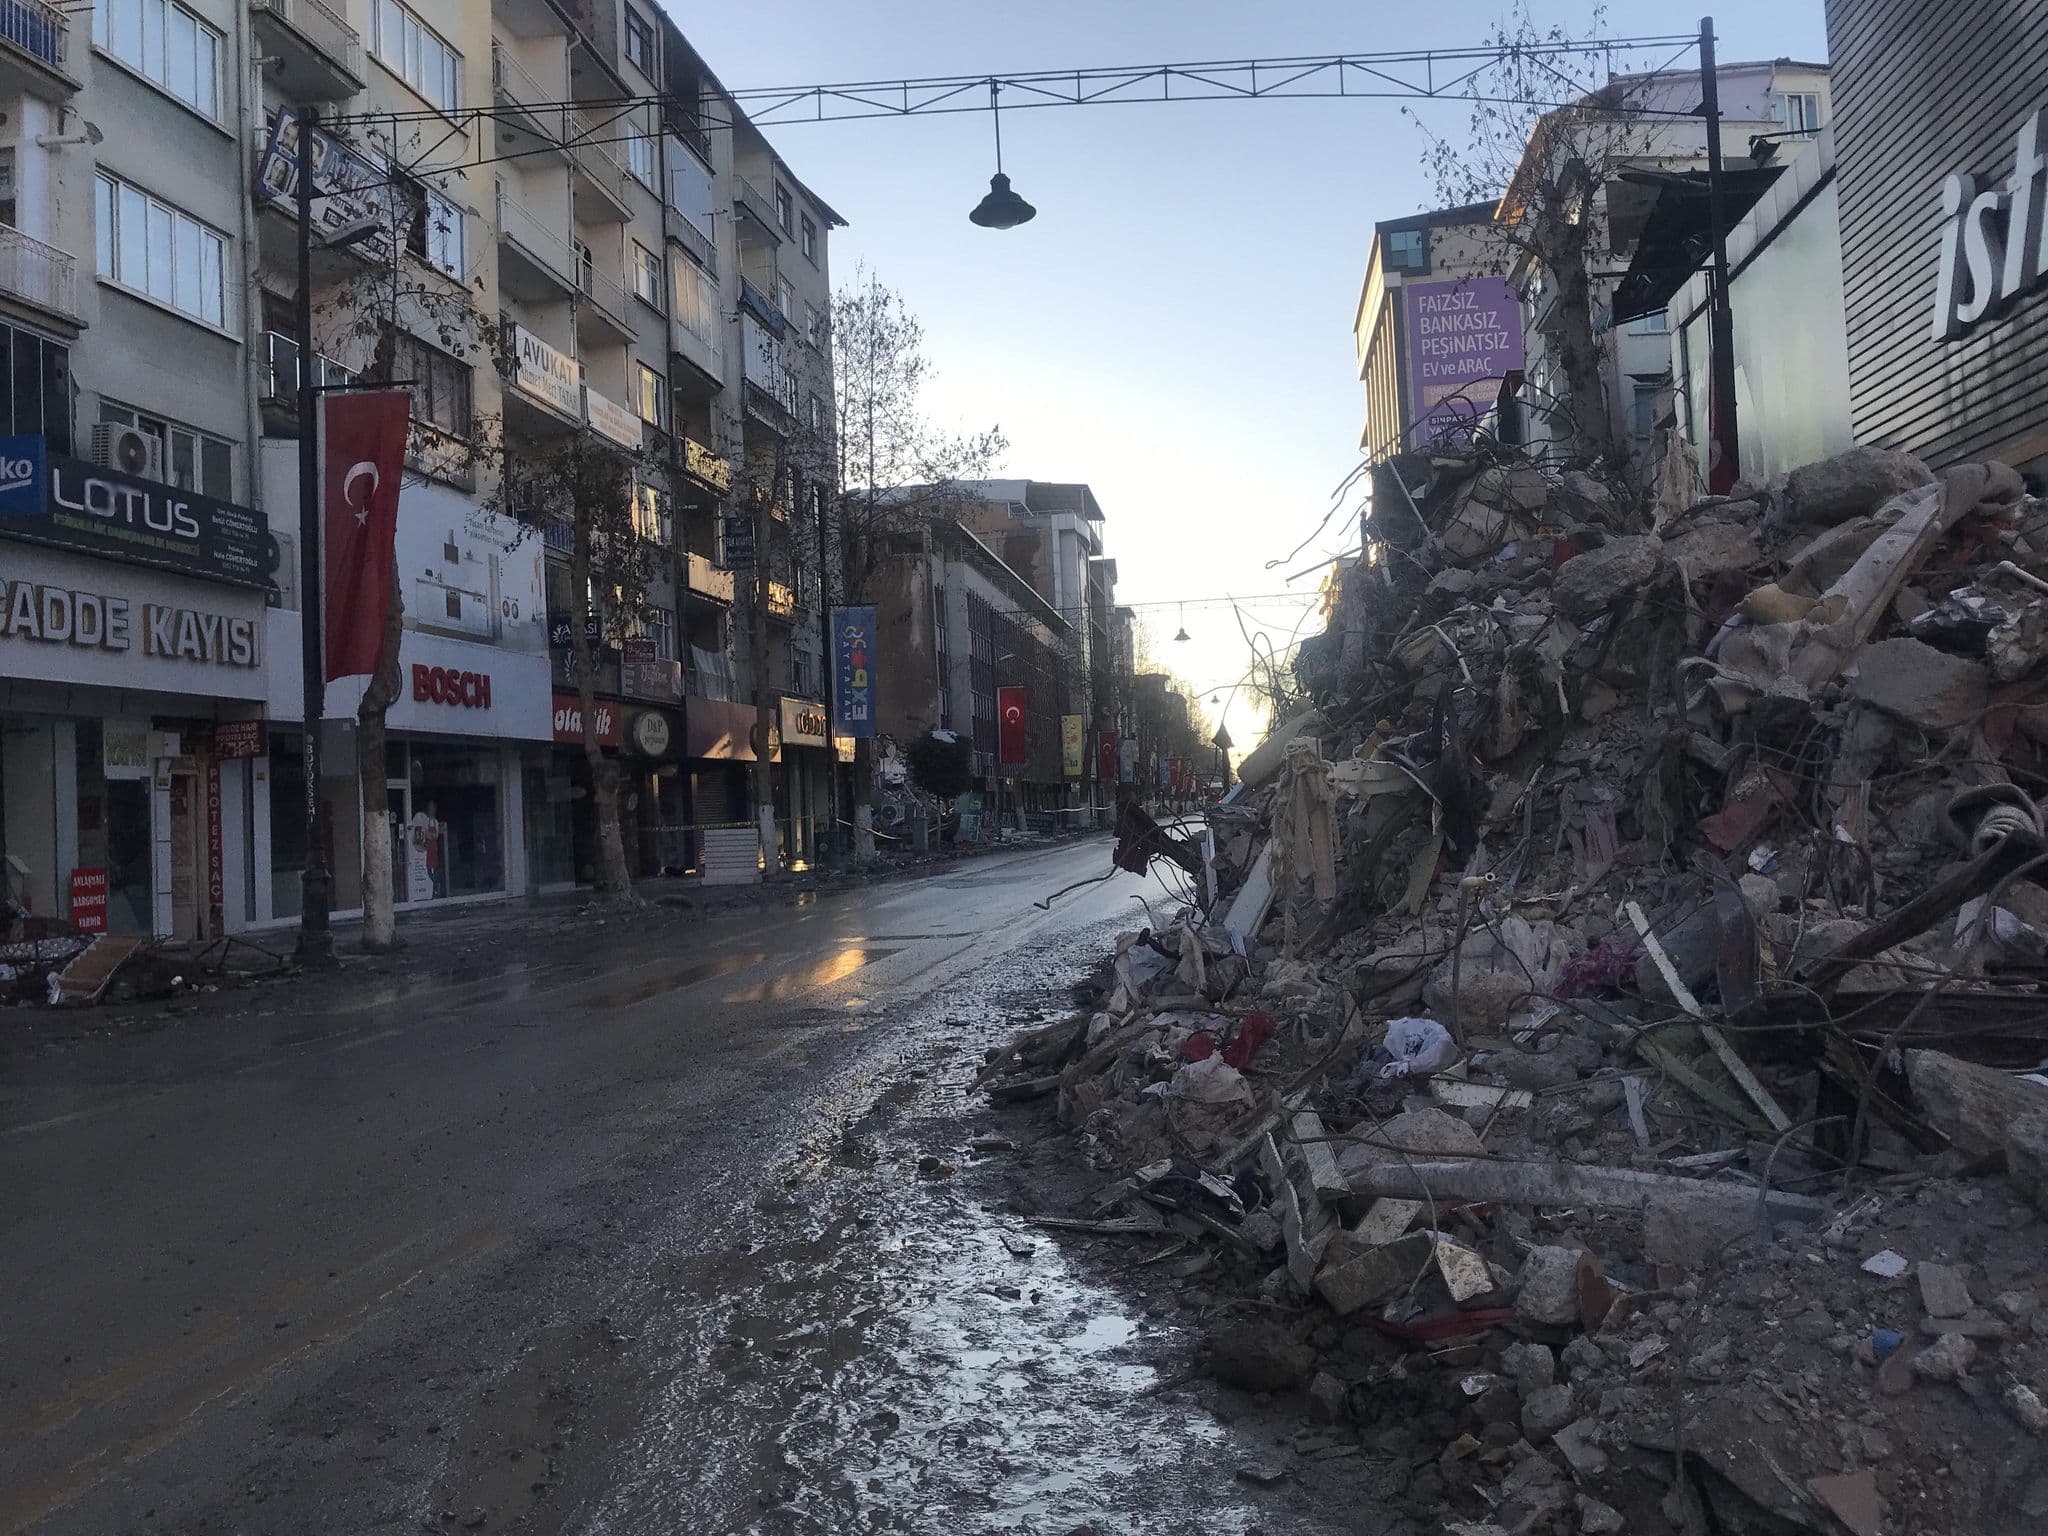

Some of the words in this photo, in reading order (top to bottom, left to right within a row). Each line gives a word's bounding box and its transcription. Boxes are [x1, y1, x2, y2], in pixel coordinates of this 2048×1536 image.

[1932, 109, 2048, 342] ist
[1420, 311, 1501, 335] BANKASIZ,
[523, 336, 573, 387] AVUKAT
[1423, 362, 1439, 378] EV
[1440, 364, 1455, 375] ve
[1458, 357, 1493, 377] ARAÇ
[53, 468, 200, 538] LOTUS
[143, 603, 261, 668] KAYISI
[412, 663, 491, 710] BOSCH
[209, 767, 220, 851] PROTEZ
[210, 855, 222, 899] SAÇ
